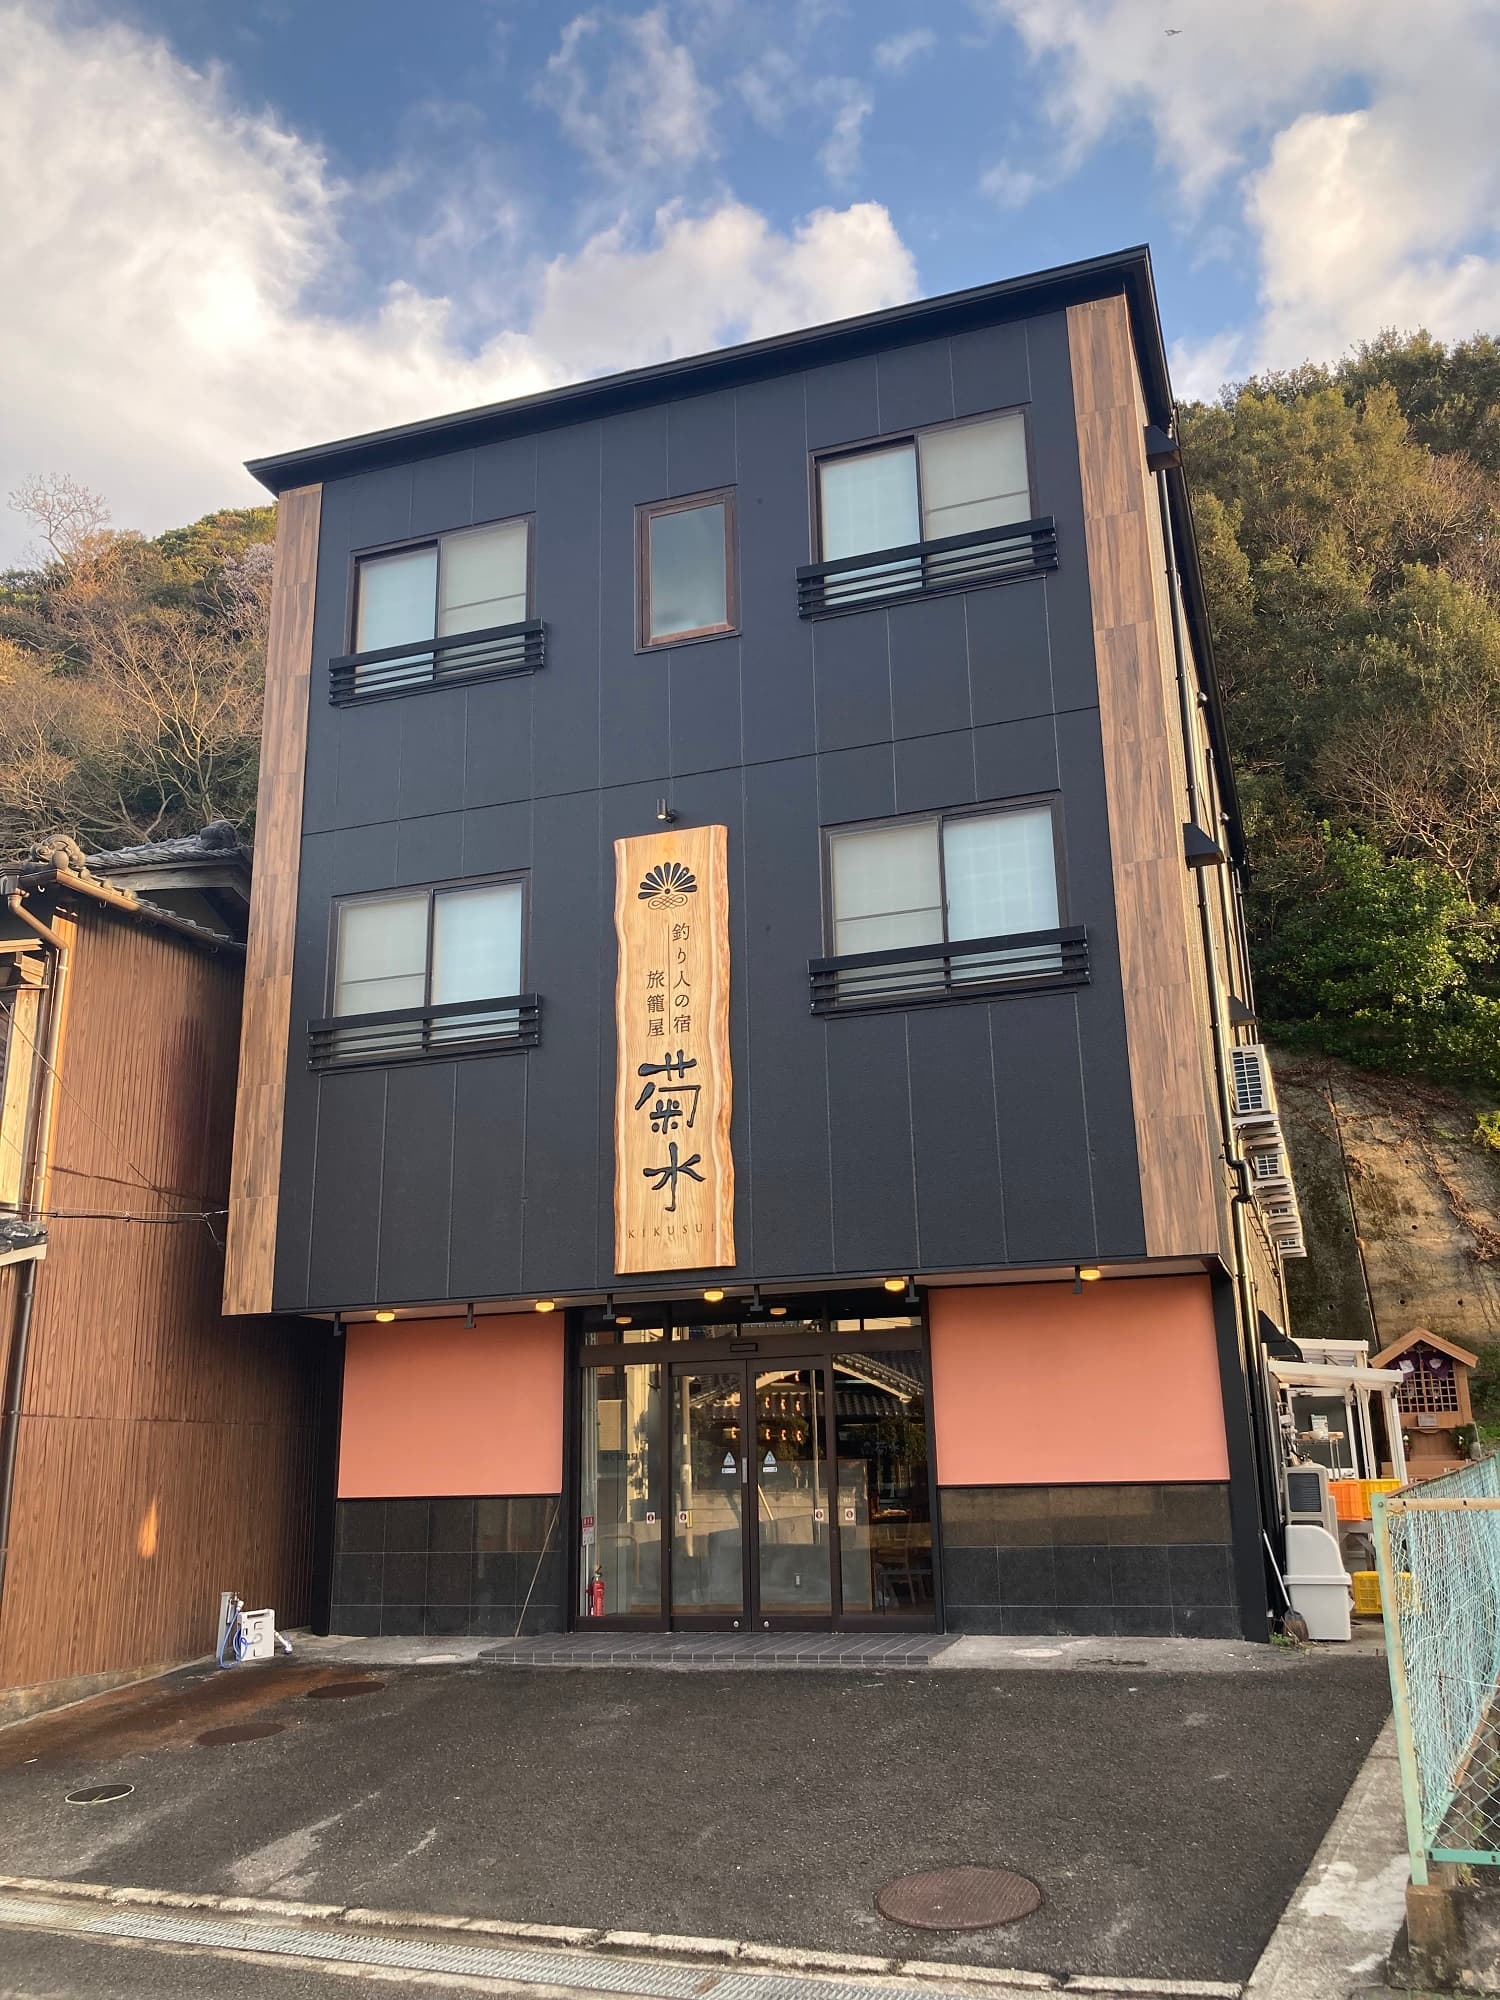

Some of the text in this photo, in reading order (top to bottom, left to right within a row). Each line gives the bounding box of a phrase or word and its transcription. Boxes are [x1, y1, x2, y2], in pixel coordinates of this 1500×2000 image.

[647, 970, 665, 1037] 旅籠屋
[672, 922, 691, 1034] 釣り人の宿
[635, 1048, 706, 1212] 菊水
[628, 1223, 716, 1239] KIKUSUI
